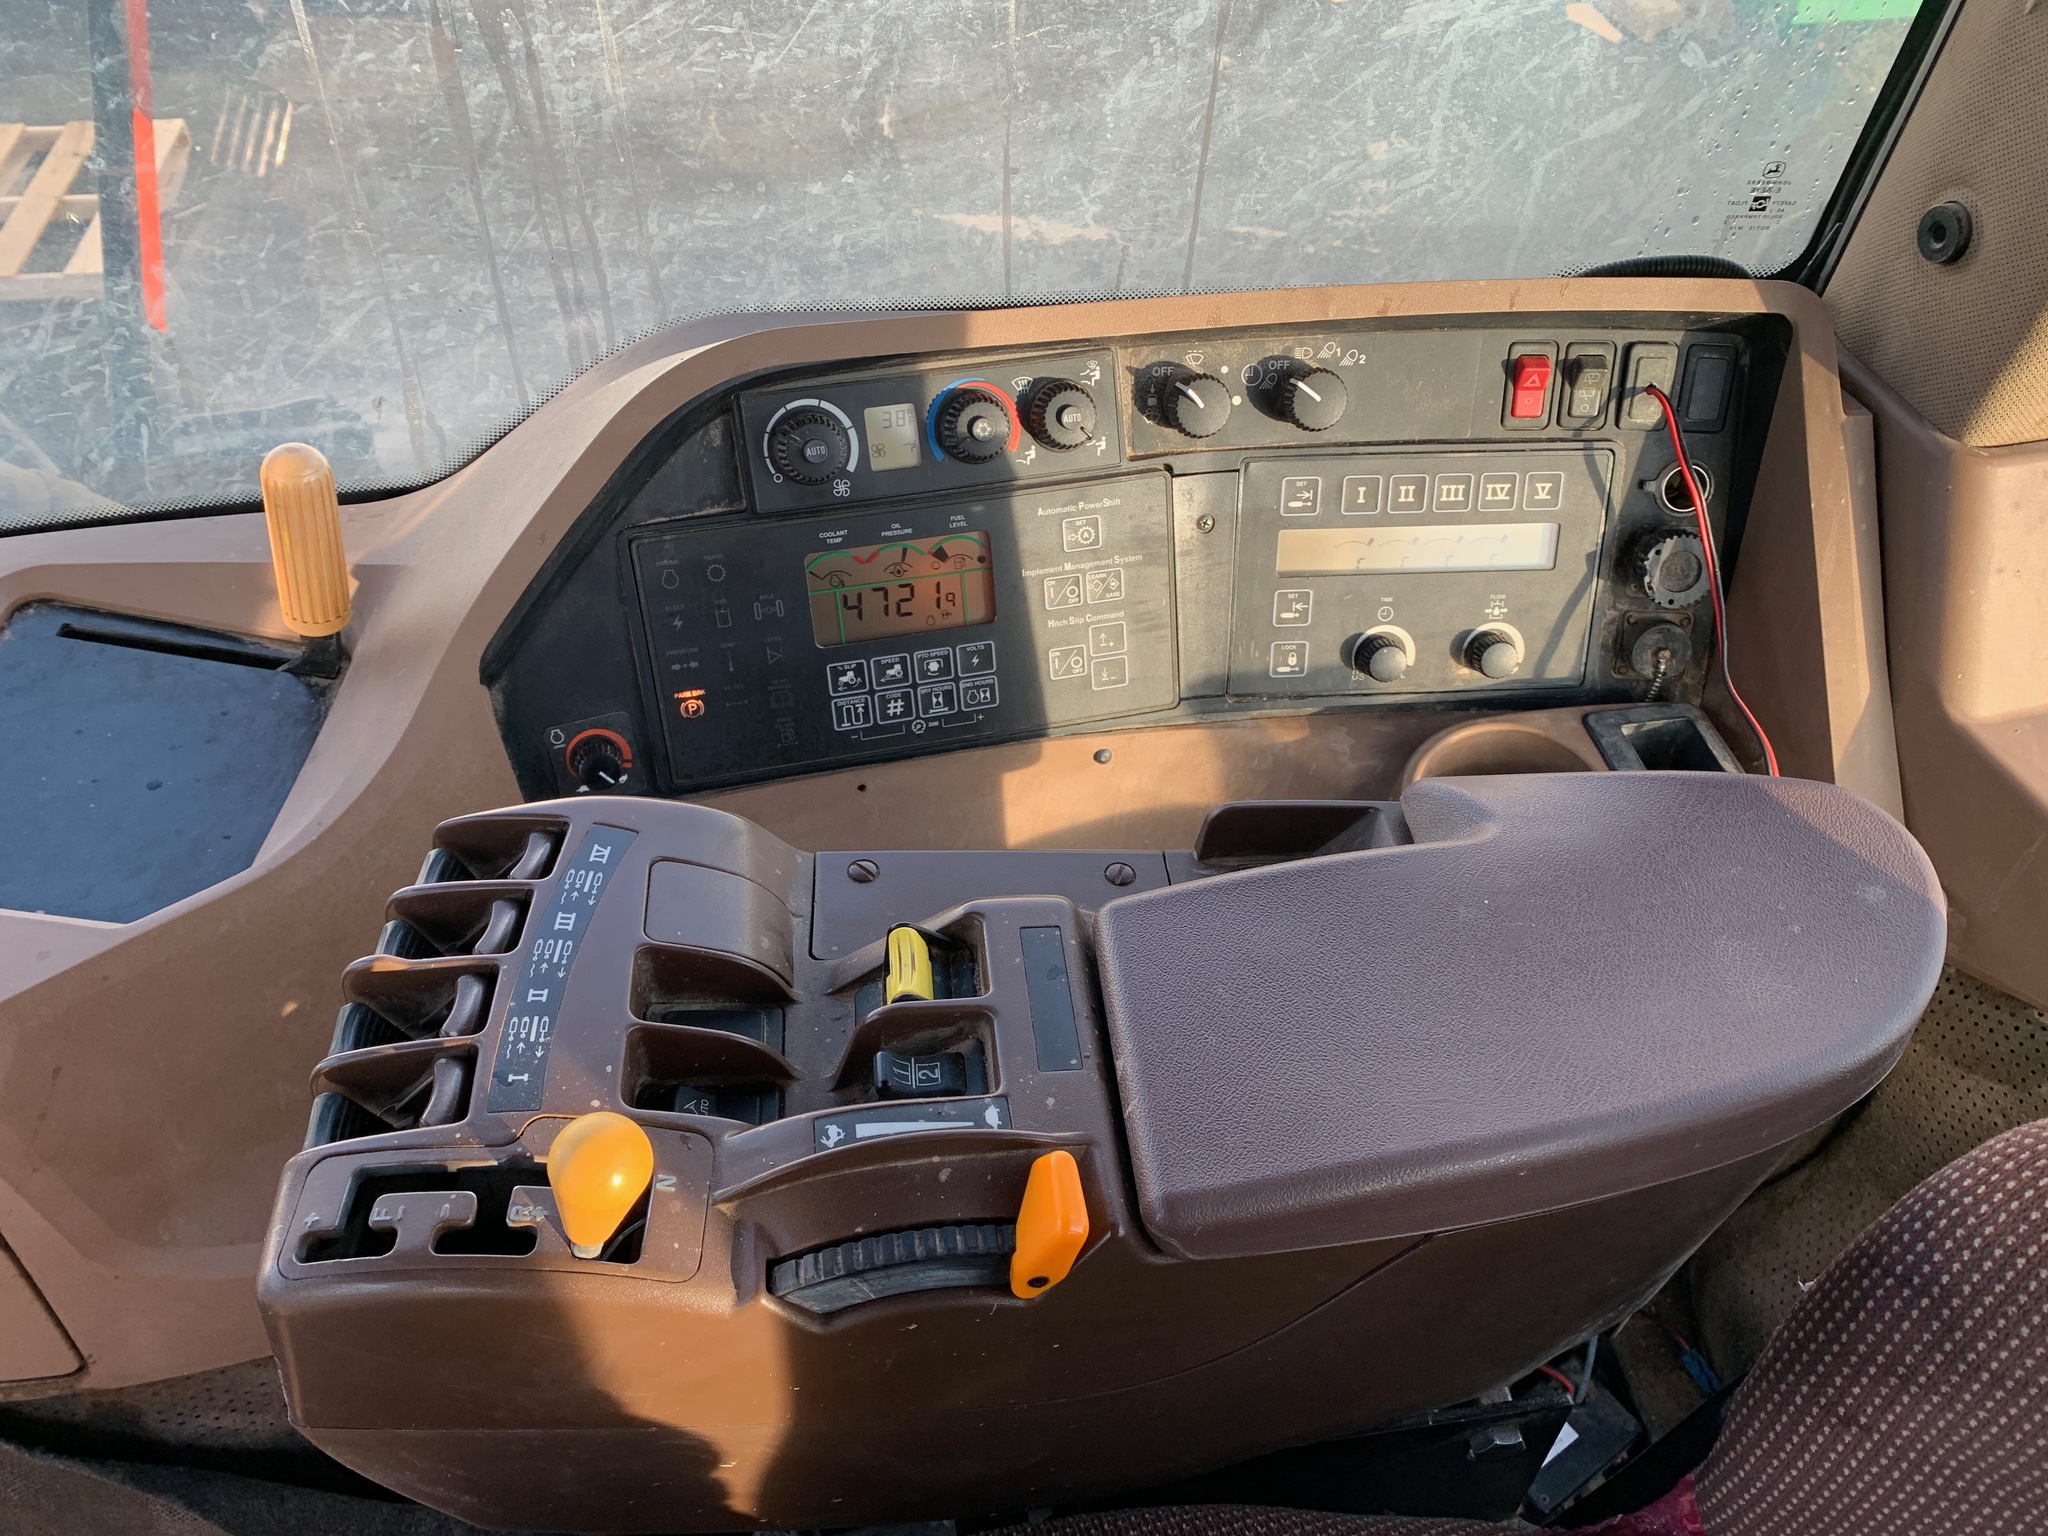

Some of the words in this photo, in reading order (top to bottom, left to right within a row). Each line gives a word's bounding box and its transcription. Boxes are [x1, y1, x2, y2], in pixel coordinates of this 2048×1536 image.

[1152, 366, 1175, 376] OFF
[1268, 360, 1290, 370] OFF
[1063, 412, 1082, 422] AUTO
[805, 445, 826, 457] AUTO
[1357, 487, 1366, 503] I
[1398, 485, 1416, 502] II
[1440, 484, 1465, 501] III
[1485, 484, 1511, 500] IV
[1534, 483, 1553, 499] V
[1037, 504, 1077, 516] Automatic
[1078, 498, 1121, 510] PowerShift
[819, 530, 848, 538] COOLANT
[881, 528, 912, 537] PRESSURE
[1022, 564, 1063, 578] Implement
[1064, 558, 1113, 572] Management
[1114, 554, 1143, 564] System
[1048, 619, 1068, 628] Hitch
[1069, 616, 1084, 626] Slip
[1085, 611, 1124, 622] Command
[966, 644, 984, 652] VOLTS
[974, 679, 993, 687] HOURS
[674, 690, 692, 699] PARK
[837, 698, 866, 707] DISTANCE
[554, 911, 577, 931] III
[527, 988, 549, 1003] II
